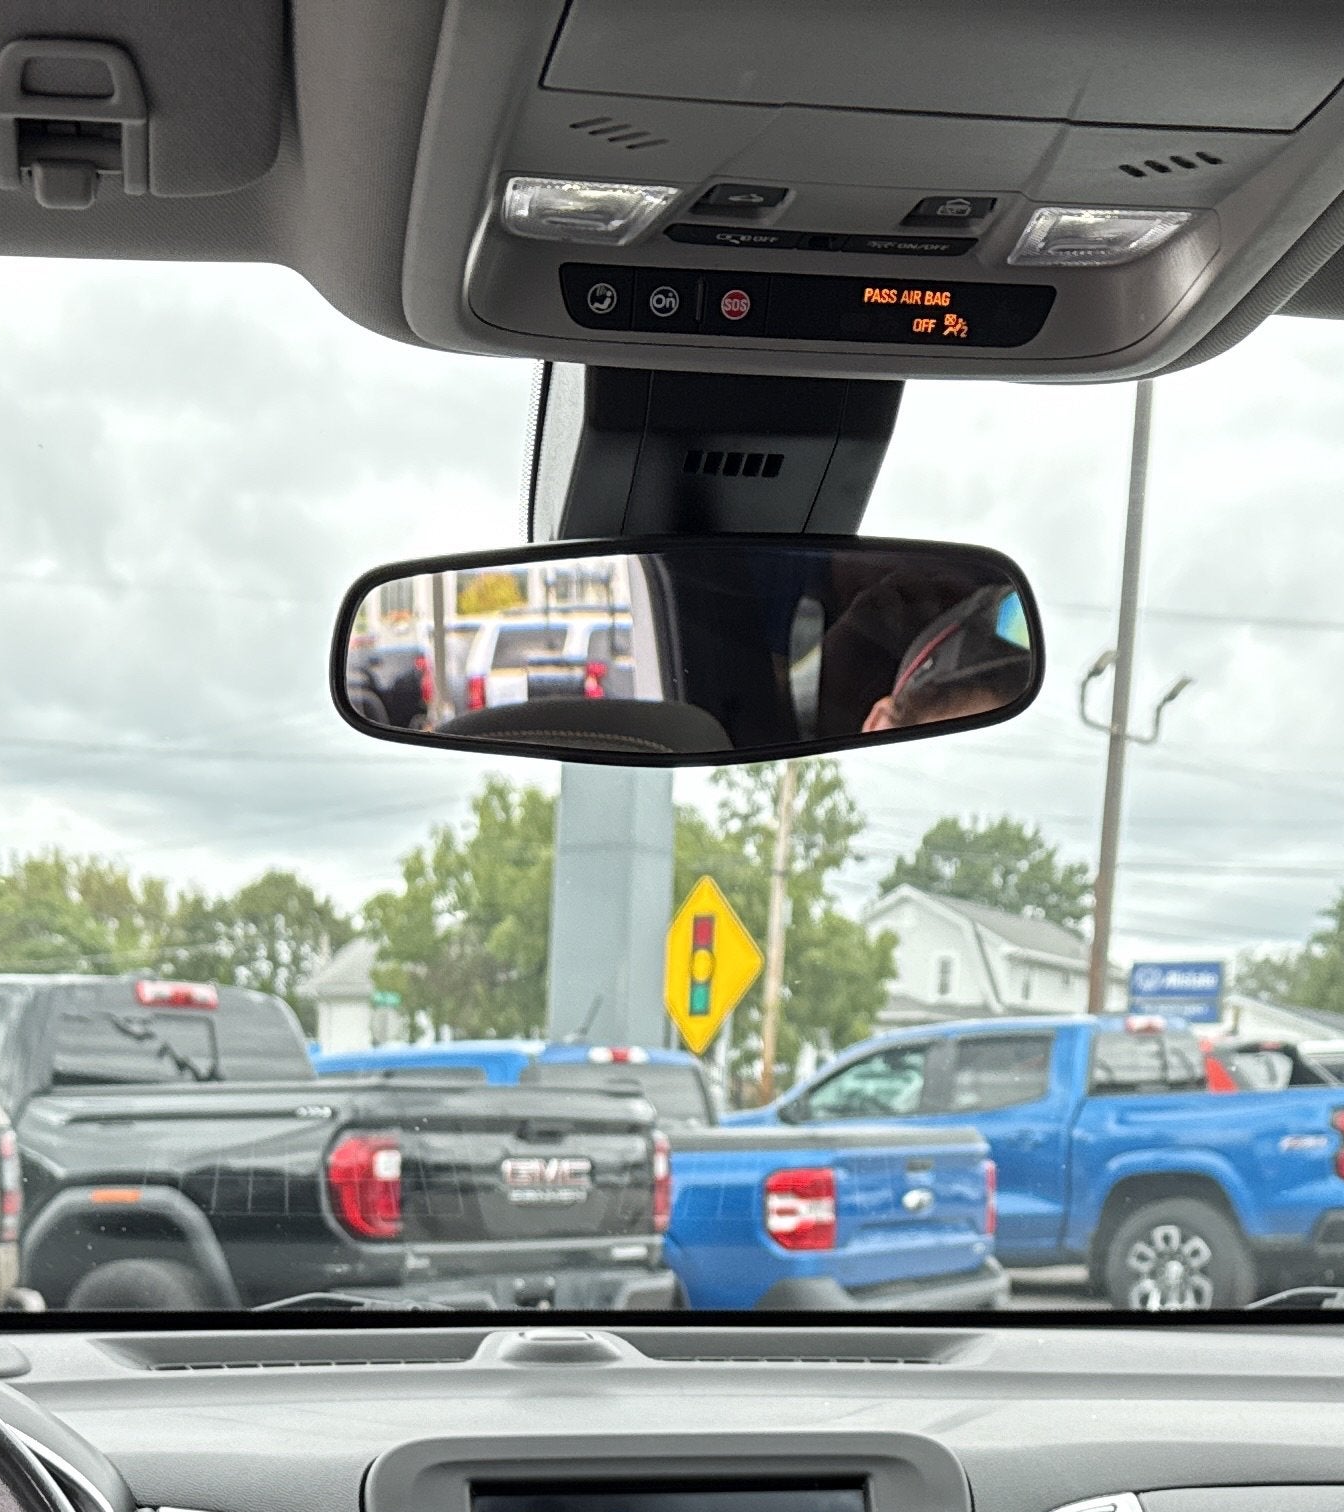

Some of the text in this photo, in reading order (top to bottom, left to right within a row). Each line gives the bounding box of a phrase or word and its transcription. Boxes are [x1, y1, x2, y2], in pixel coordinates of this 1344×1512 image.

[723, 298, 748, 311] SOS
[864, 288, 950, 306] PASS AIR BAG
[913, 318, 936, 333] OFF
